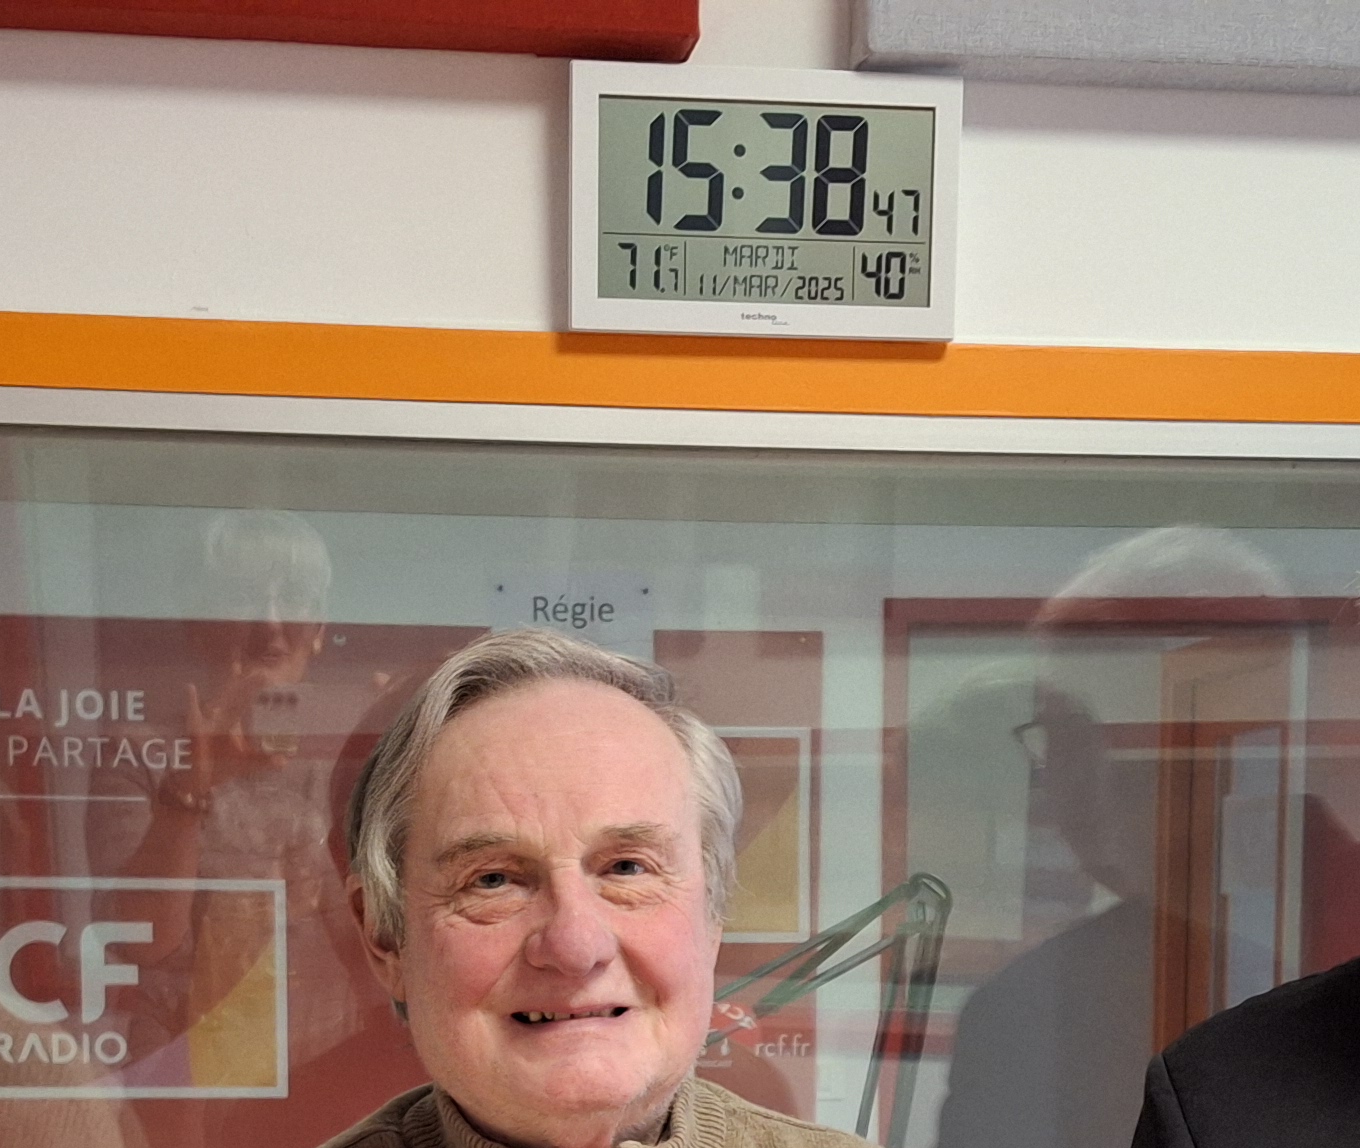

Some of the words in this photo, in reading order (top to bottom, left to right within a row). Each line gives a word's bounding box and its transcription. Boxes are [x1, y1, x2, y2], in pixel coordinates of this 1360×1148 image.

[646, 108, 869, 236] 15:38
[872, 188, 921, 236] 47
[723, 244, 800, 271] MARDI
[699, 273, 845, 301] 11/MAR/2025
[861, 251, 907, 300] 40
[532, 594, 615, 629] Régie
[55, 689, 146, 727] JOIE
[7, 735, 193, 770] PARTAGE
[755, 1033, 810, 1057] rcf.fr
